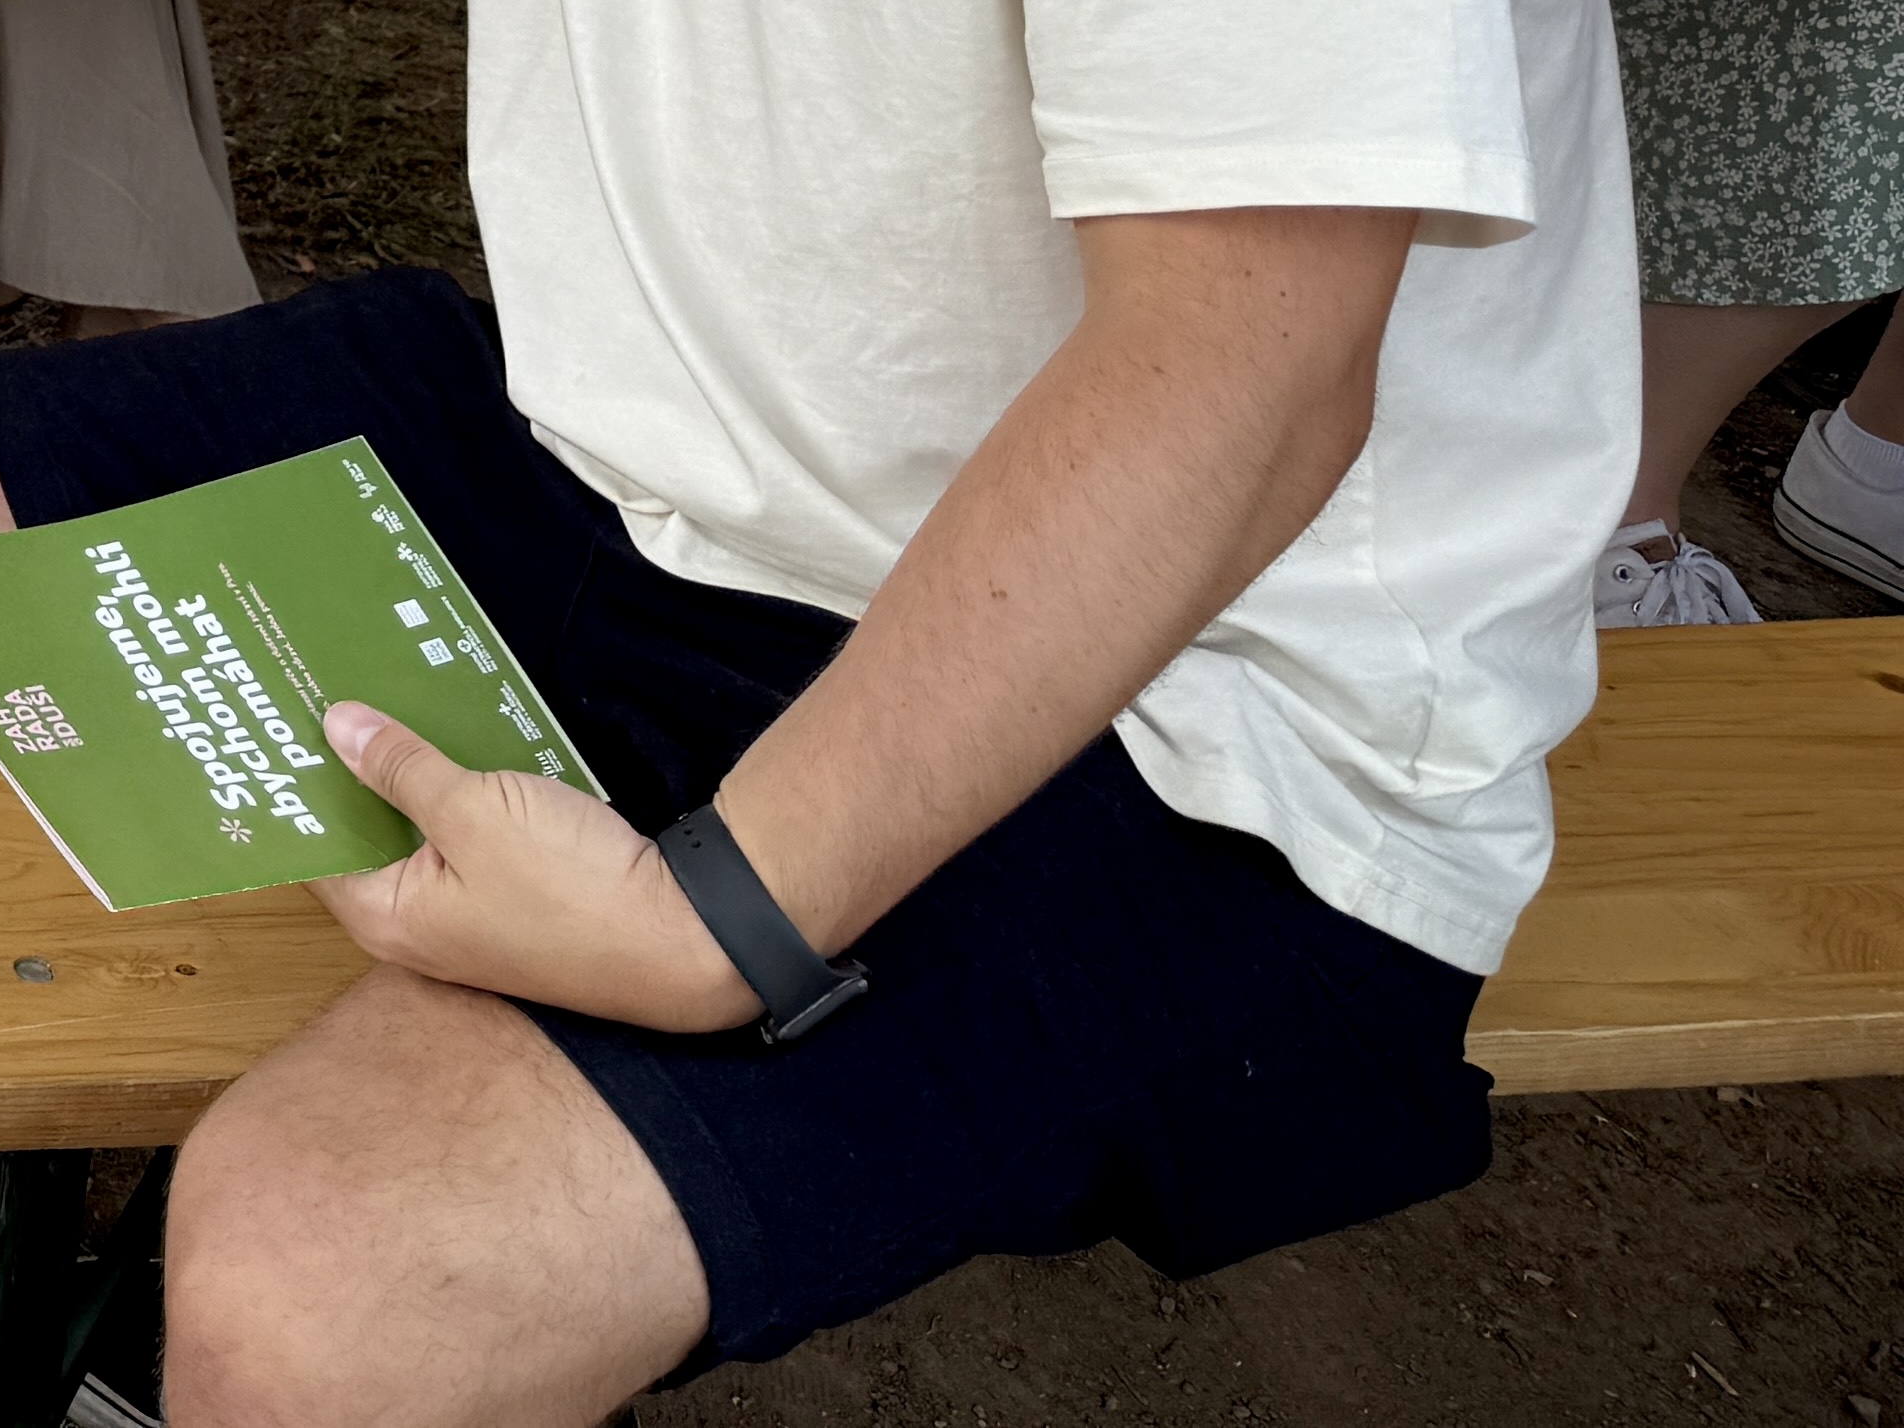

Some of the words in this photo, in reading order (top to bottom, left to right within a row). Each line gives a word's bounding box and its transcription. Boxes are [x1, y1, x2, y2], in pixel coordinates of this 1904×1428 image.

[85, 541, 189, 655] mohli
[4, 689, 61, 751] RADA
[24, 685, 78, 738] DUŠI
[94, 595, 257, 810] Spojujeme,
[174, 594, 325, 768] pomáhat
[181, 667, 325, 835] abychom
